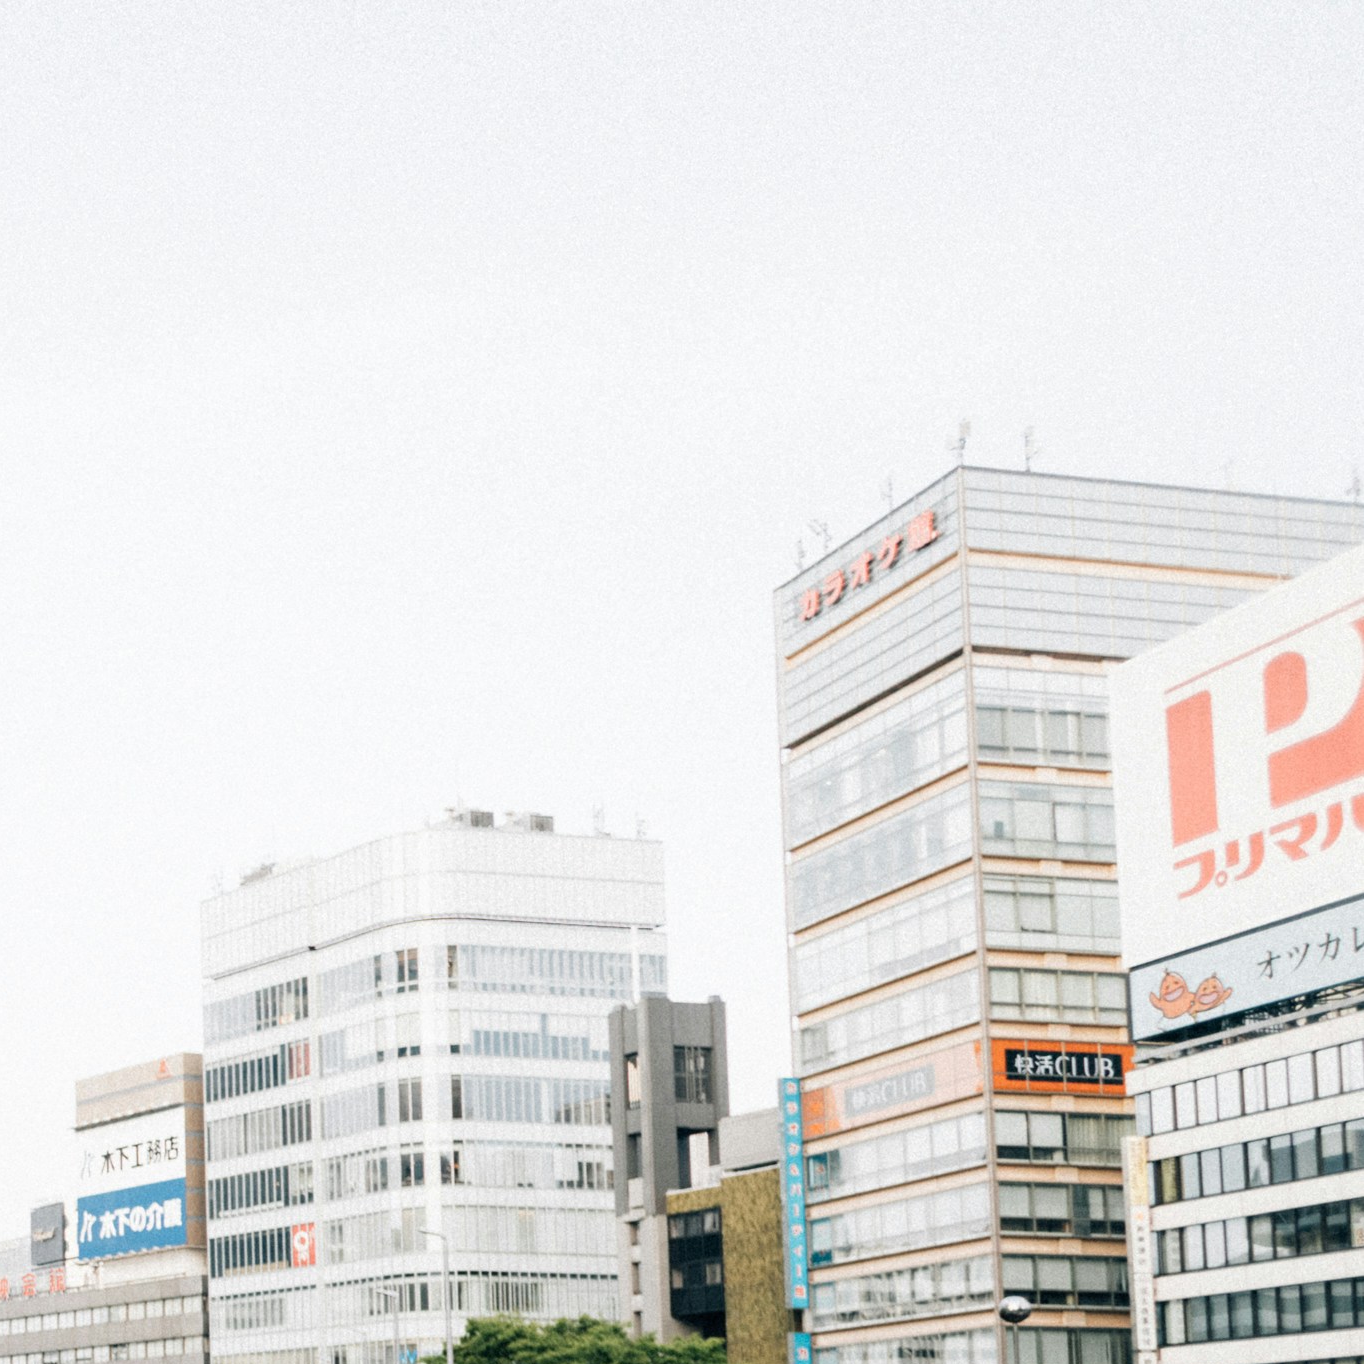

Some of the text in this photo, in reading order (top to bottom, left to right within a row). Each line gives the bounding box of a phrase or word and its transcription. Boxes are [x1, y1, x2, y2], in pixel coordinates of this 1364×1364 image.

[100, 1136, 179, 1174] 木下工務店
